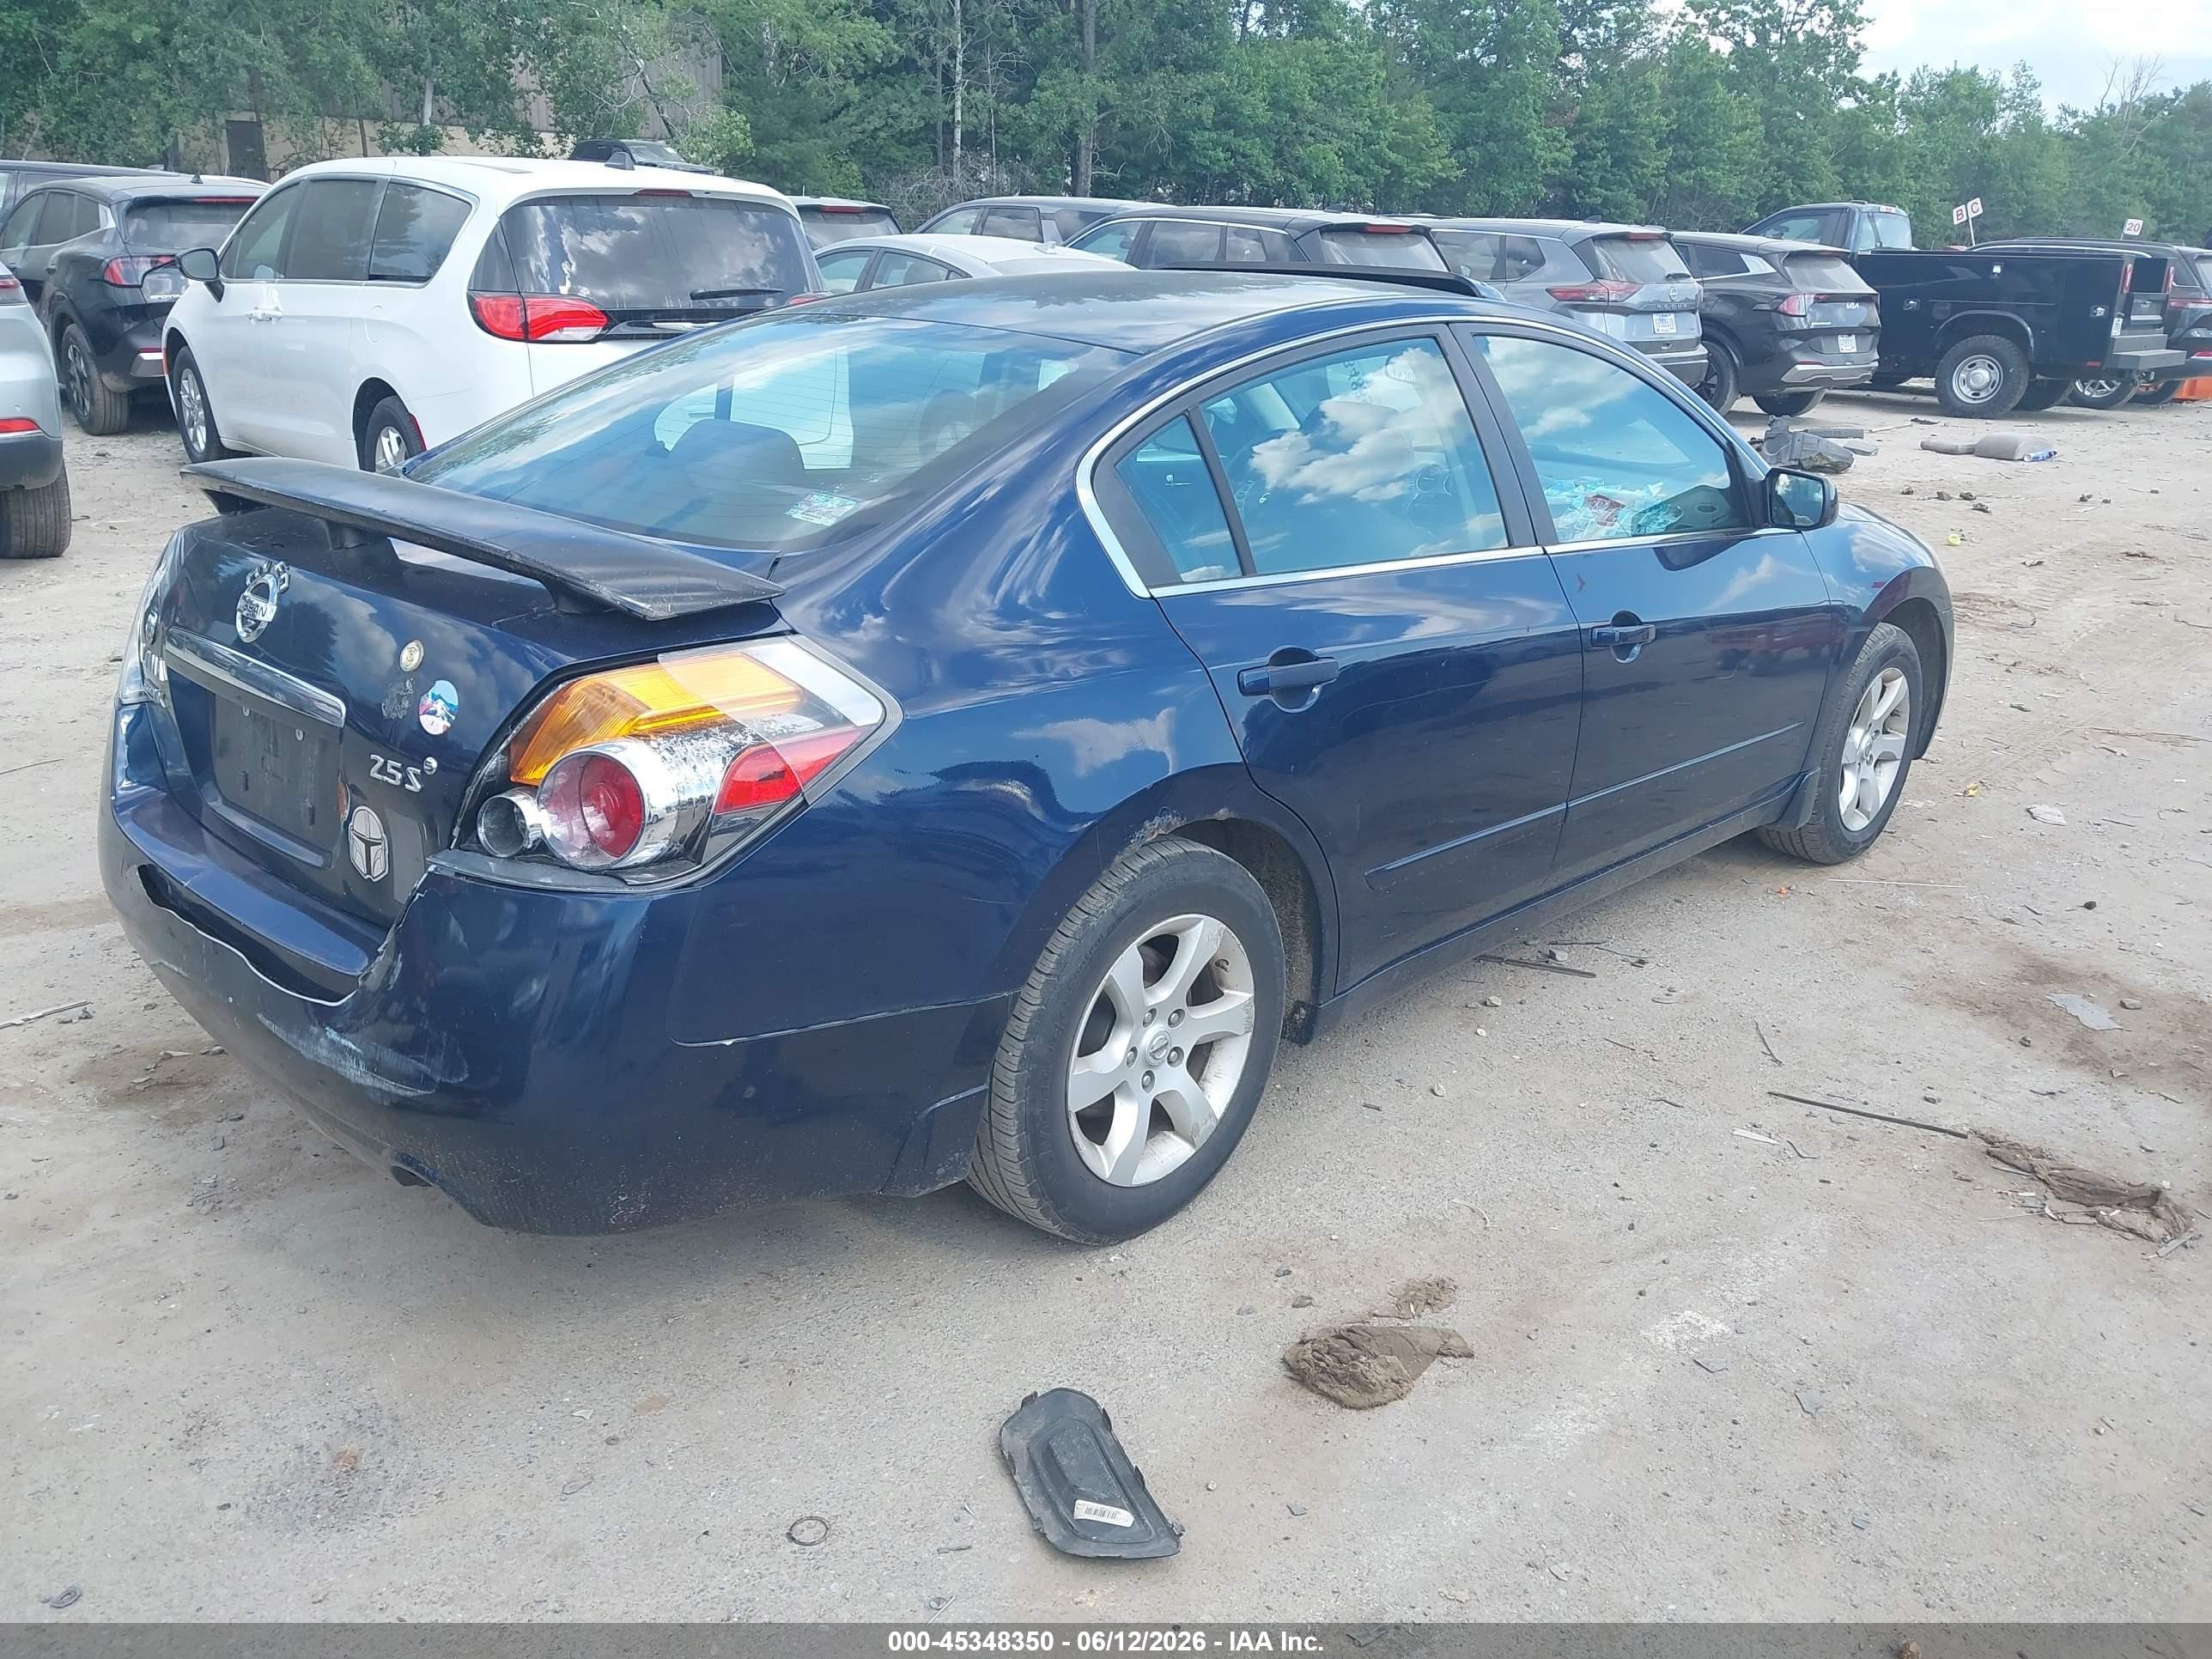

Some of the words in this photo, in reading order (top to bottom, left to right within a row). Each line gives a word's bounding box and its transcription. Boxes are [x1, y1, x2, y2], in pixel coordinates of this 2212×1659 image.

[1970, 201, 1980, 214] C
[1955, 210, 1964, 220] B
[2126, 222, 2141, 232] 20
